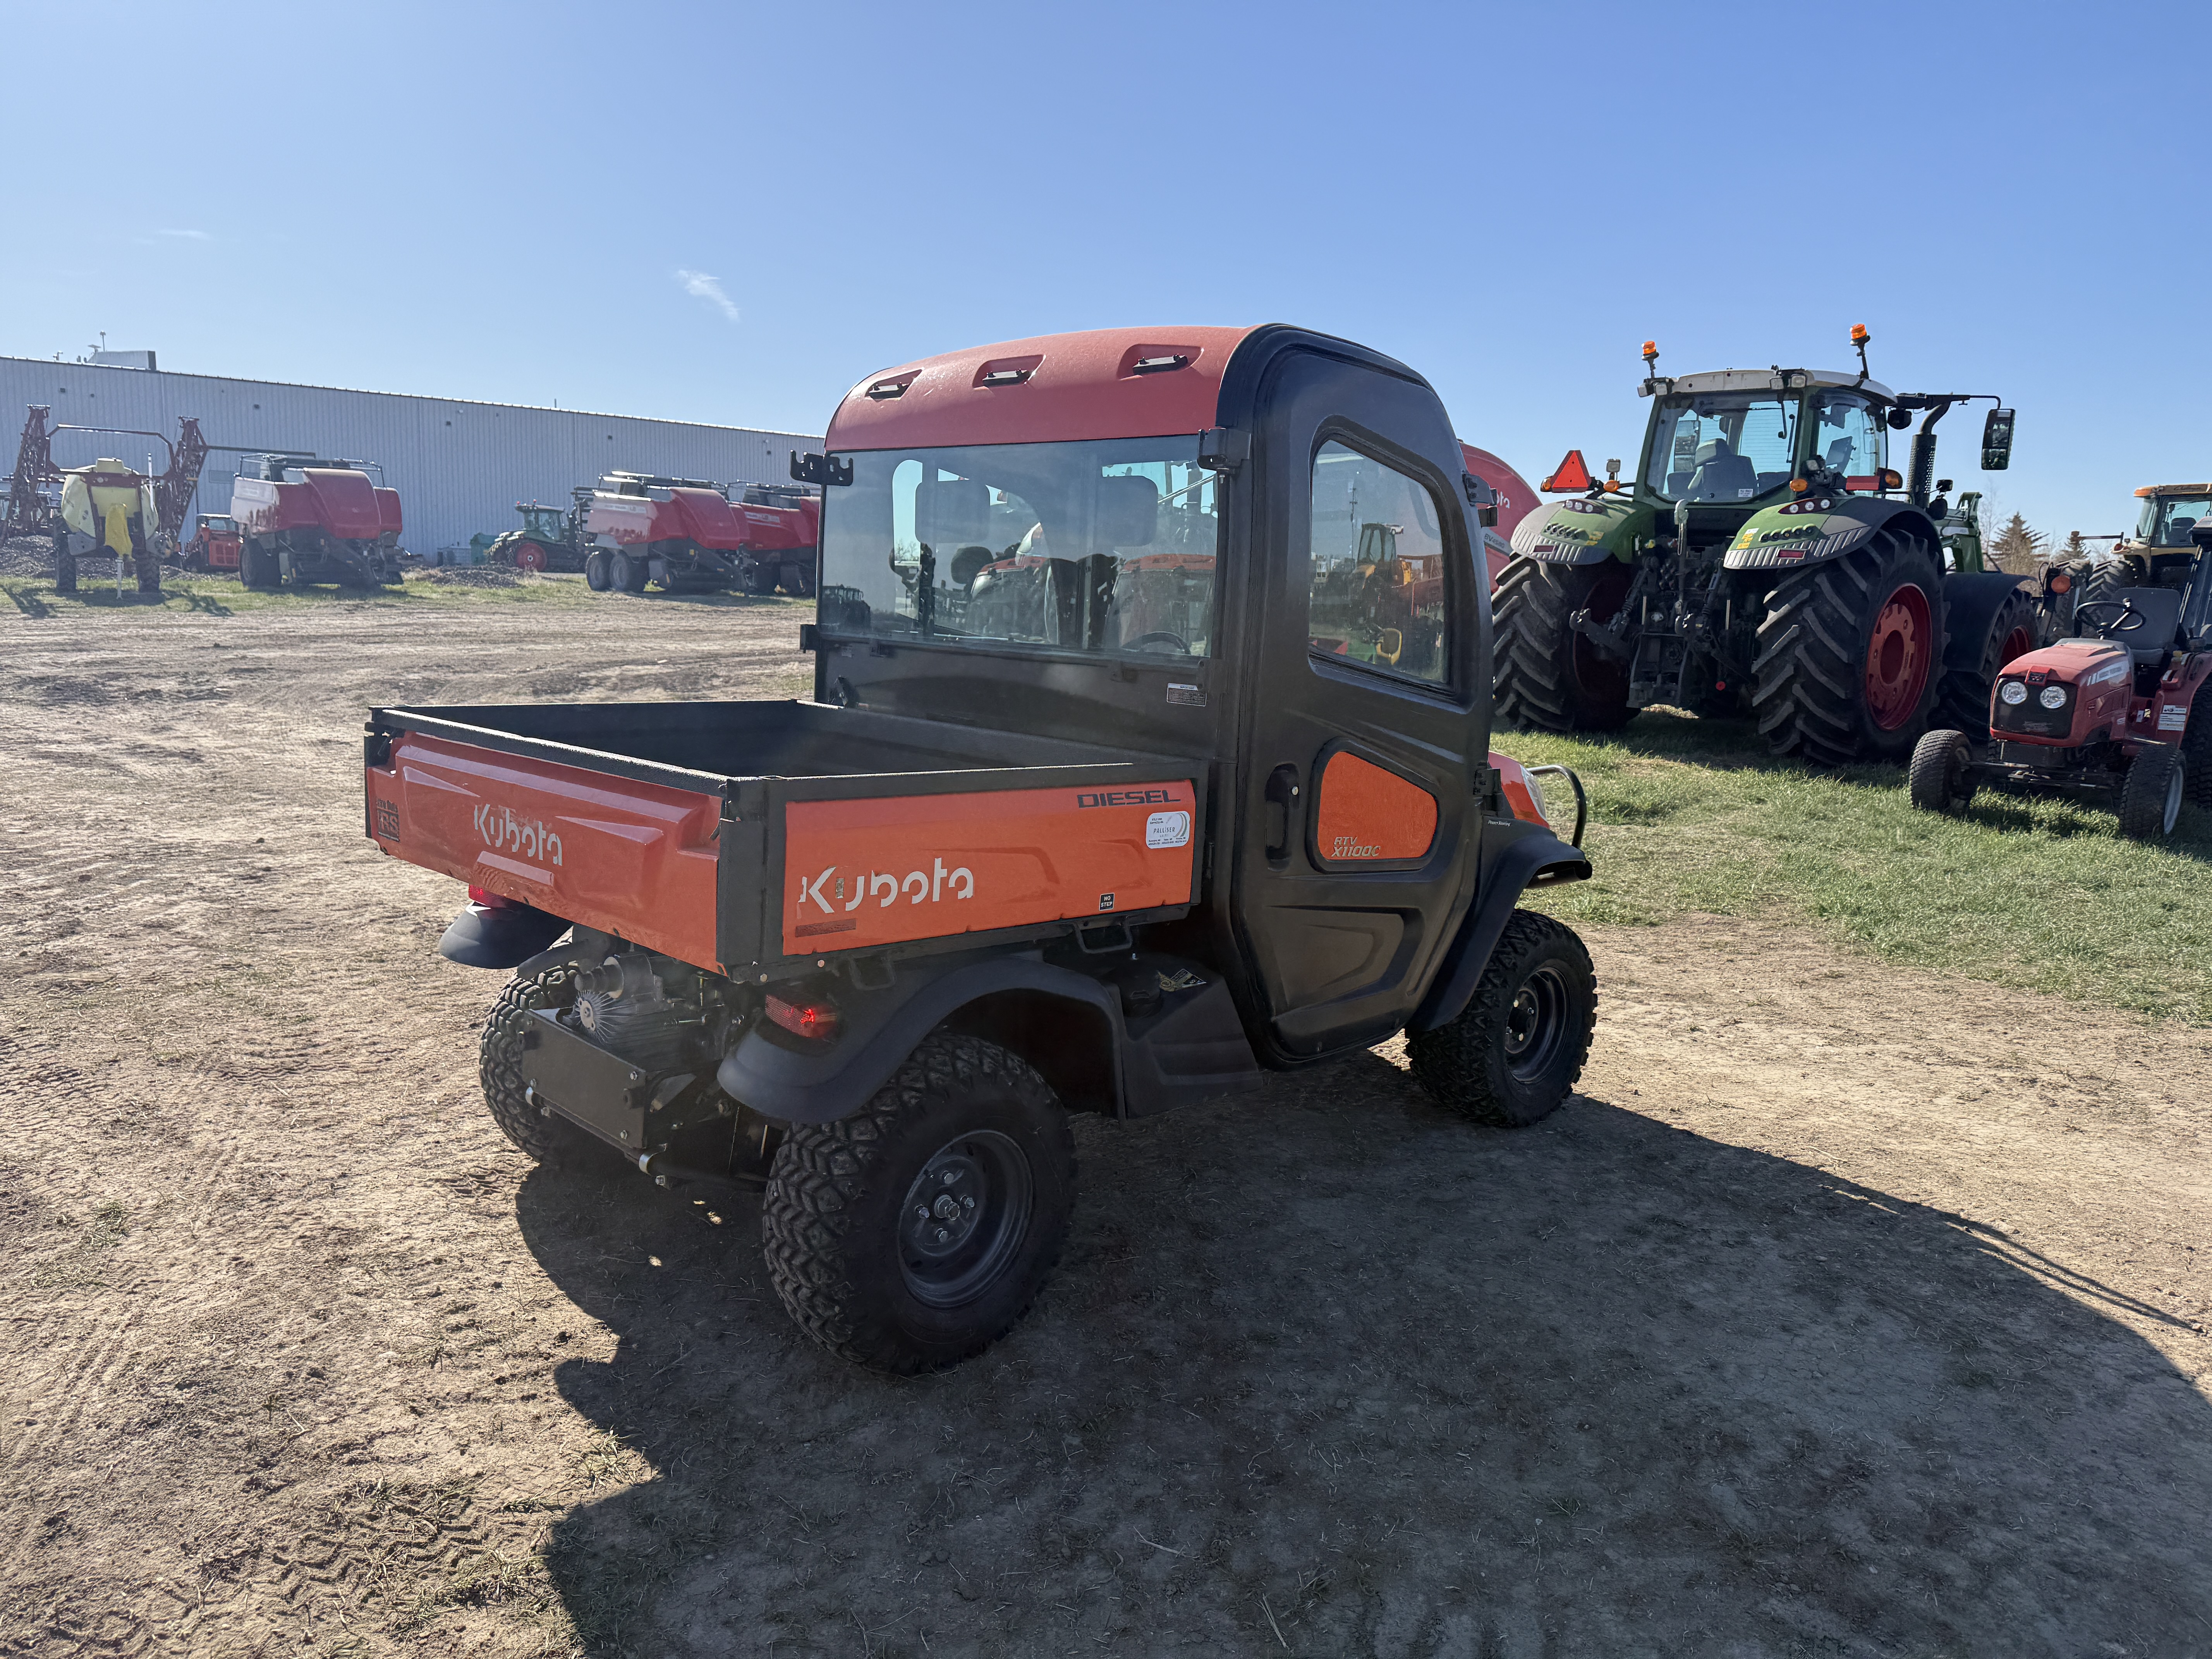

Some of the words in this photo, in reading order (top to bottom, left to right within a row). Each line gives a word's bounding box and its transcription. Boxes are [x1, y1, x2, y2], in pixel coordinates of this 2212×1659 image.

[1077, 790, 1181, 808] DIESEL
[474, 804, 562, 866] Kubota
[1334, 836, 1358, 845] RTV
[1331, 845, 1381, 857] X1100C
[797, 857, 974, 914] Kubota
